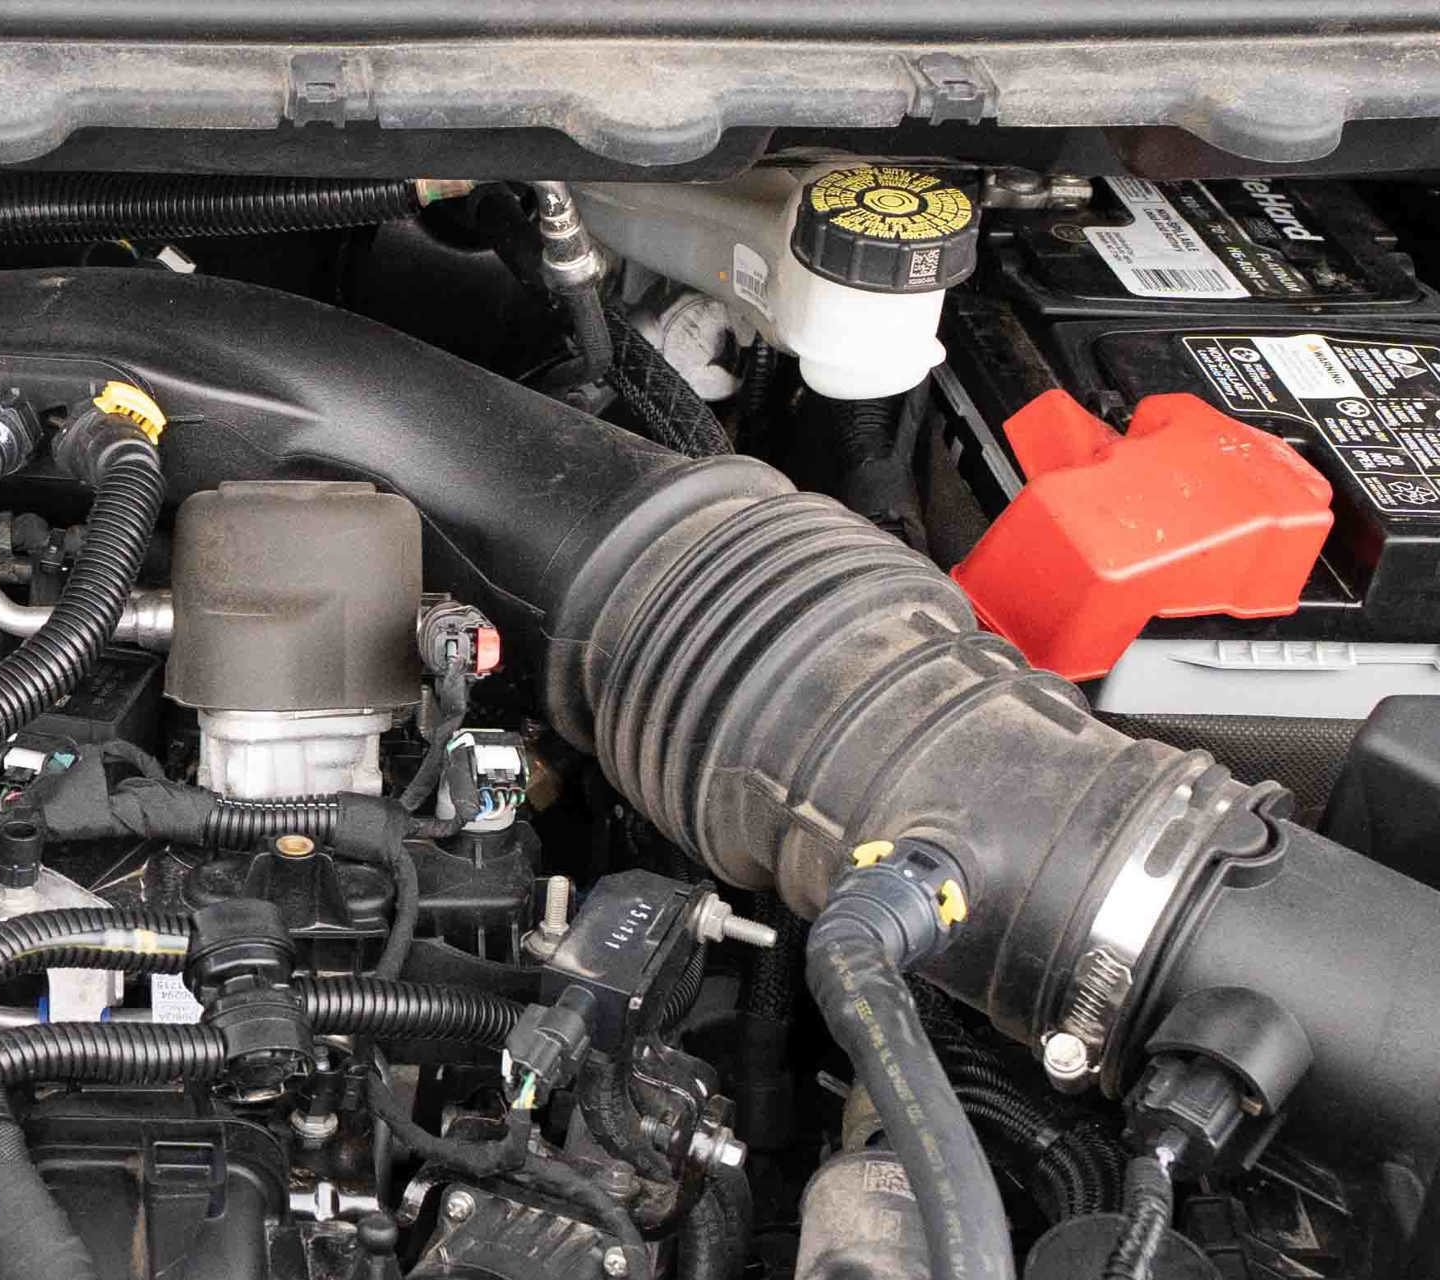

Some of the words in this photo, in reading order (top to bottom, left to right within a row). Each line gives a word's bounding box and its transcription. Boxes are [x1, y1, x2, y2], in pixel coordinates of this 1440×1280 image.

[1255, 253, 1301, 291] PLATINUM
[1204, 346, 1256, 400] NON-SPILLABLE
[1309, 350, 1348, 384] WARNING
